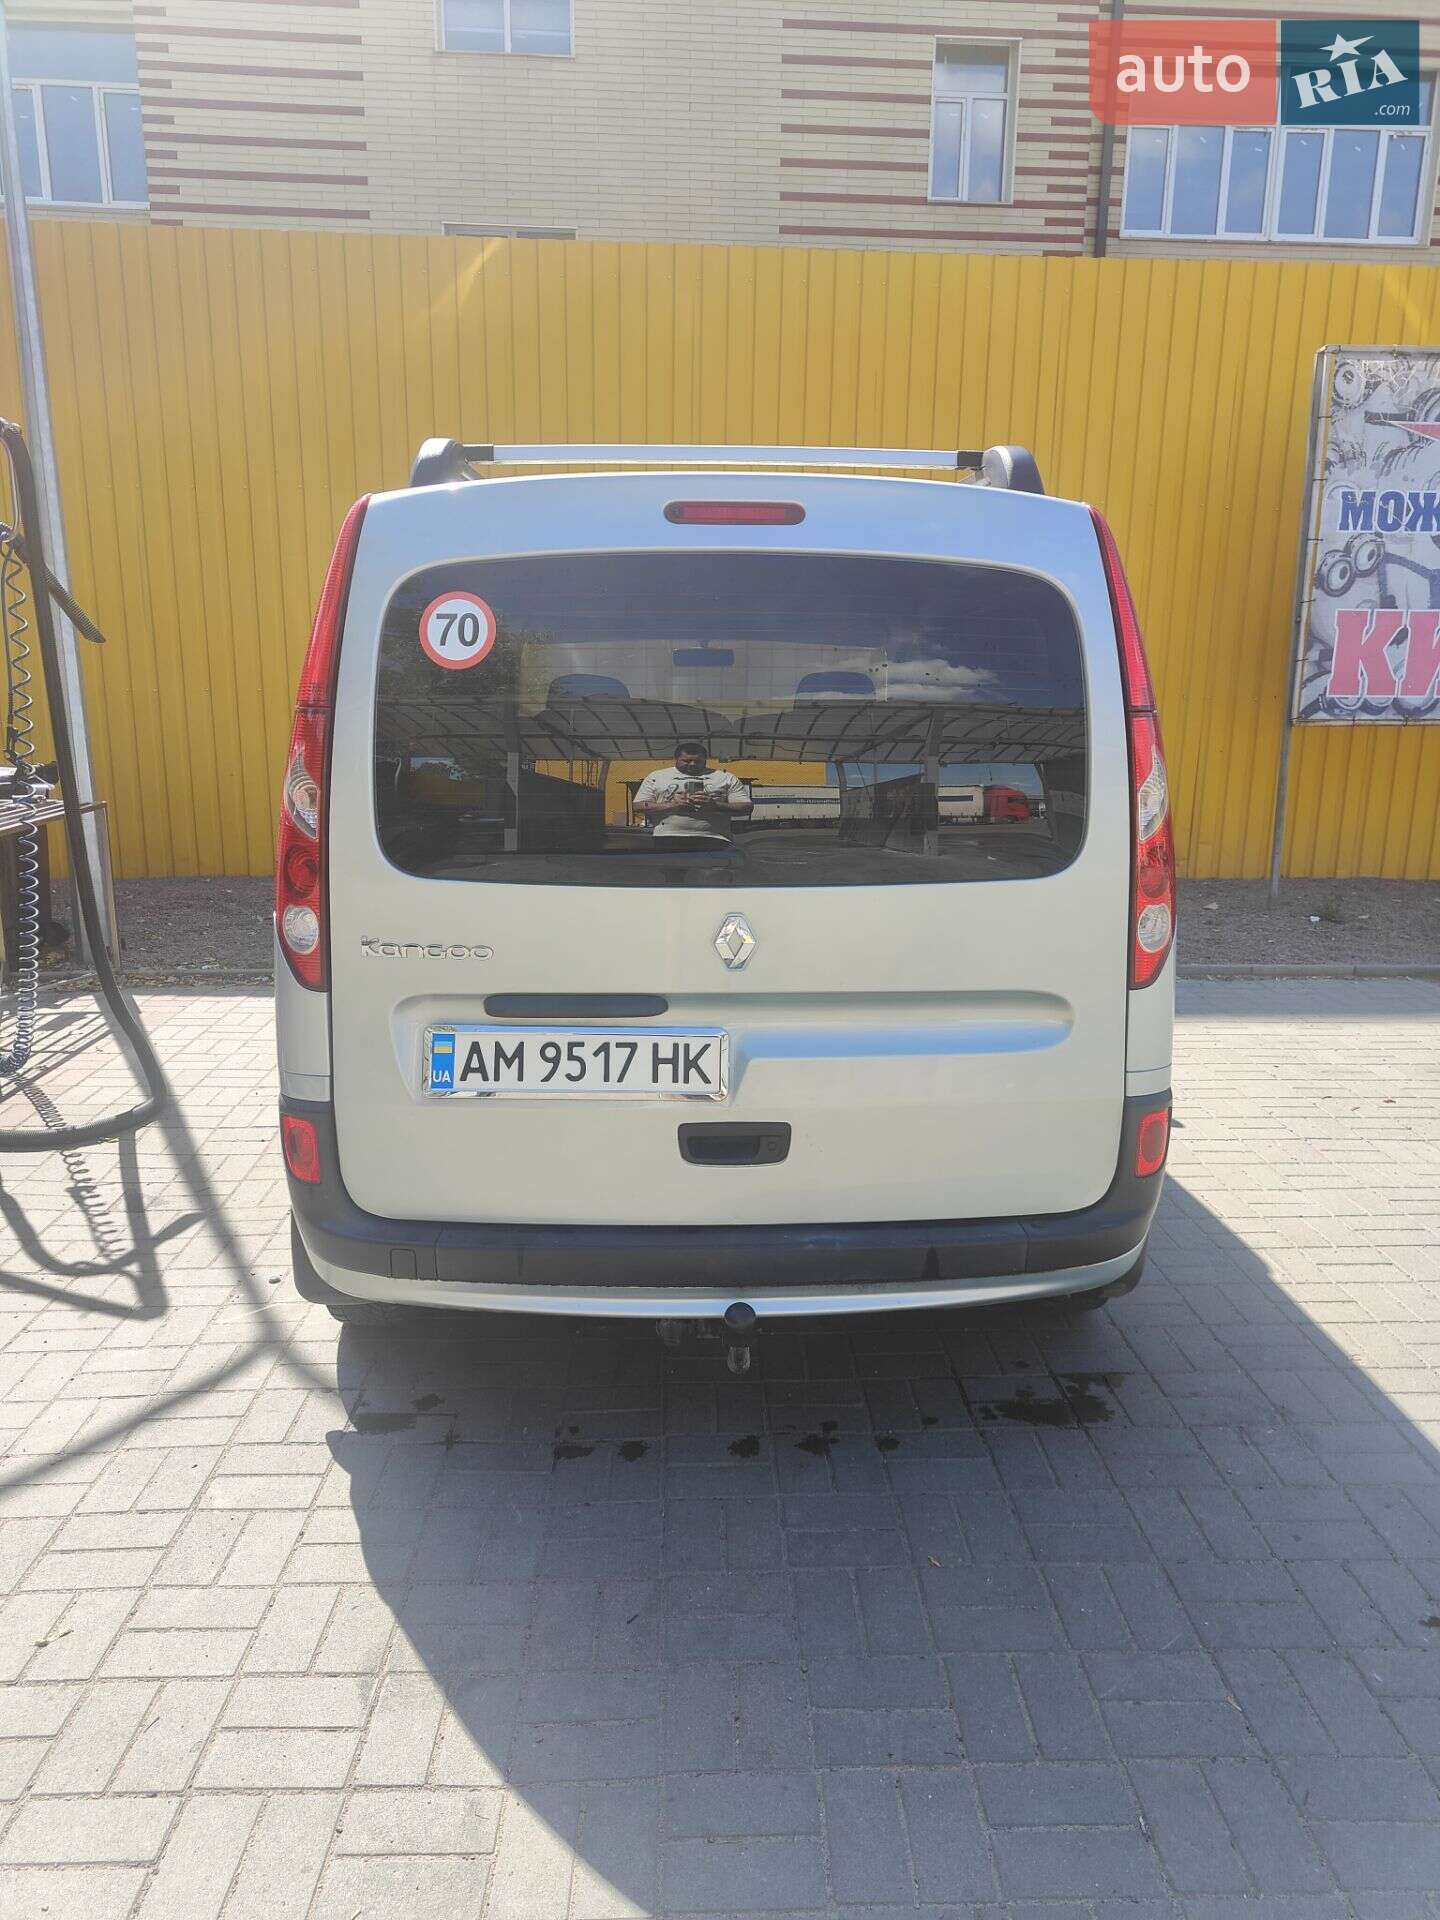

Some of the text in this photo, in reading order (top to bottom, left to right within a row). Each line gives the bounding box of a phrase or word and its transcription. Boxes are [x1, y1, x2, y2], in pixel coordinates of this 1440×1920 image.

[436, 612, 480, 647] 70
[360, 935, 495, 960] Kangoo
[432, 1069, 452, 1083] UA
[459, 1040, 712, 1085] AM 9517 HK
